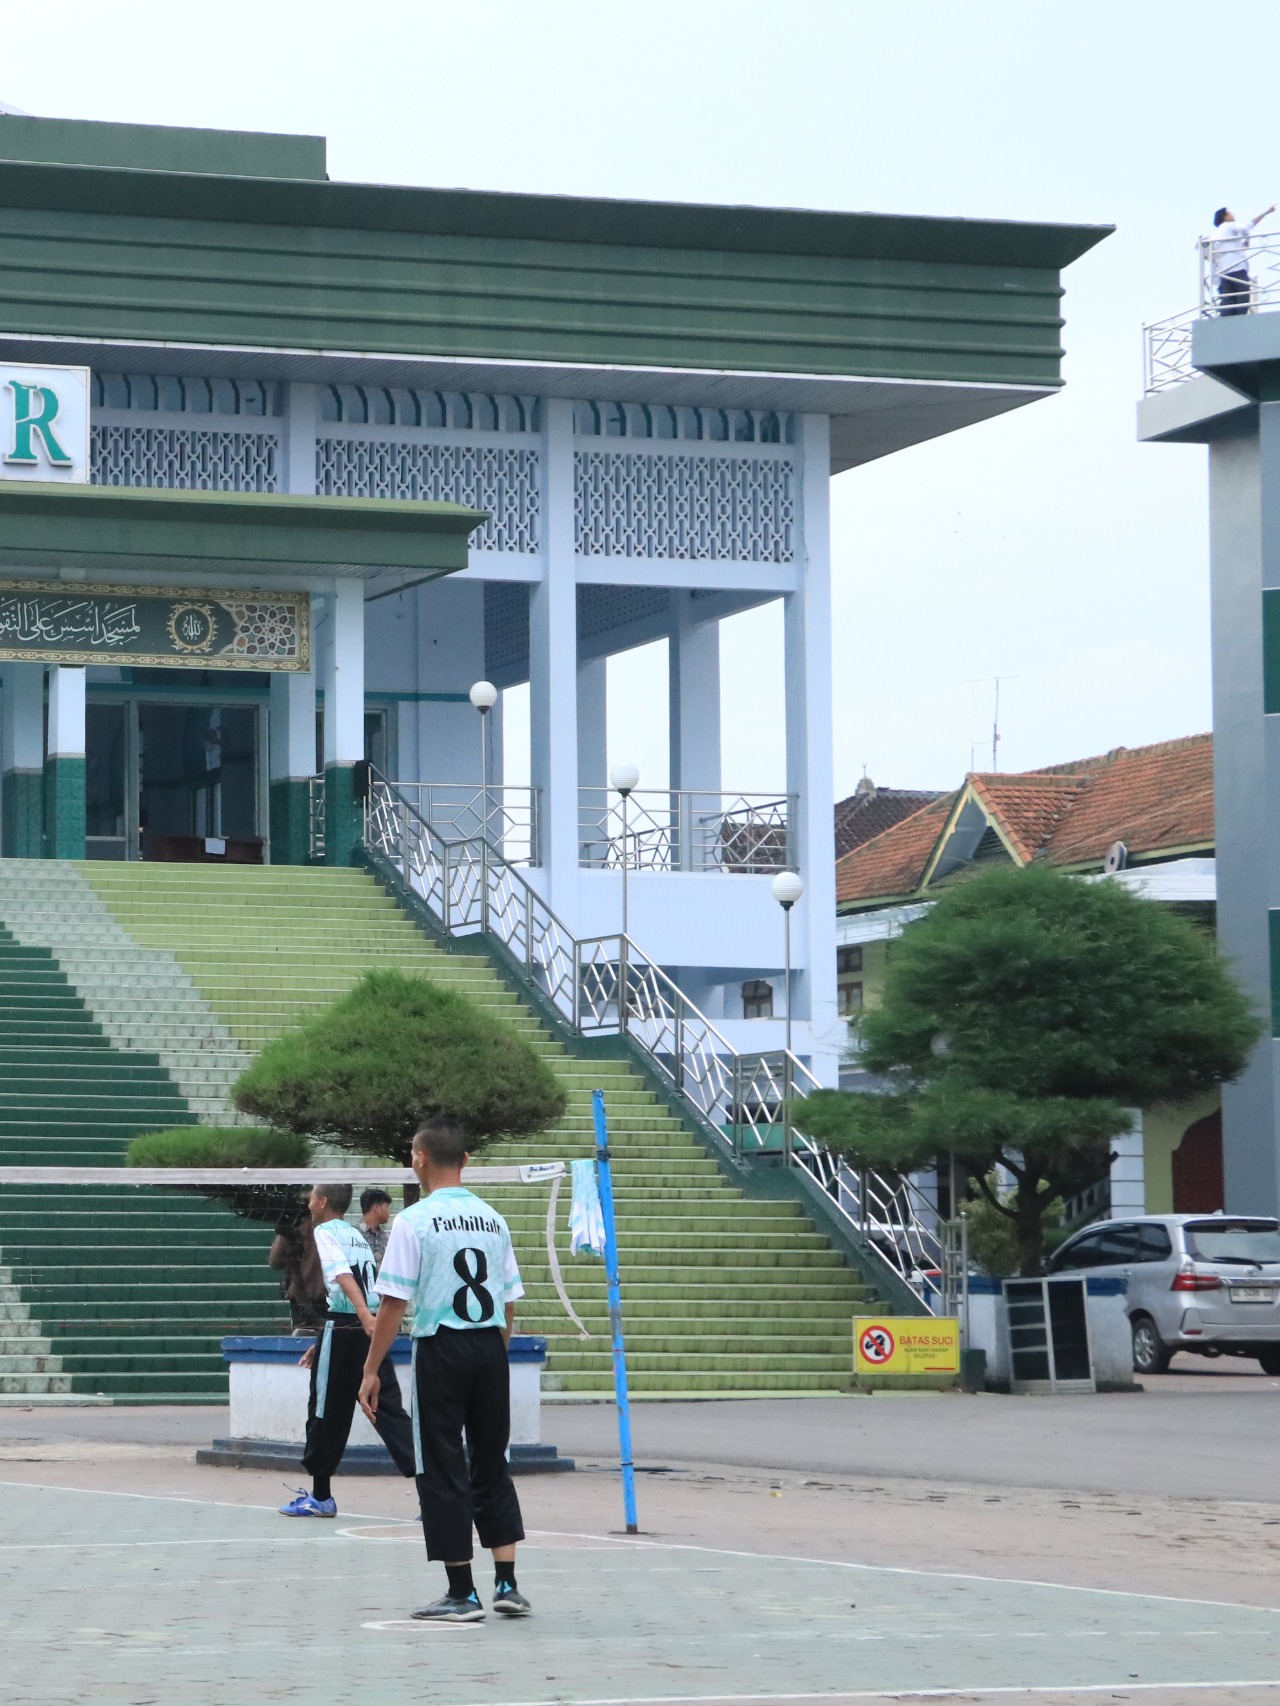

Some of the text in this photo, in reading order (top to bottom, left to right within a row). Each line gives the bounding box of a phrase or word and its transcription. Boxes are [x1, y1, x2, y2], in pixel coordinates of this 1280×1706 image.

[432, 1214, 501, 1236] Fathillah
[452, 1247, 495, 1323] 8
[899, 1336, 953, 1345] BATAS SUCI
